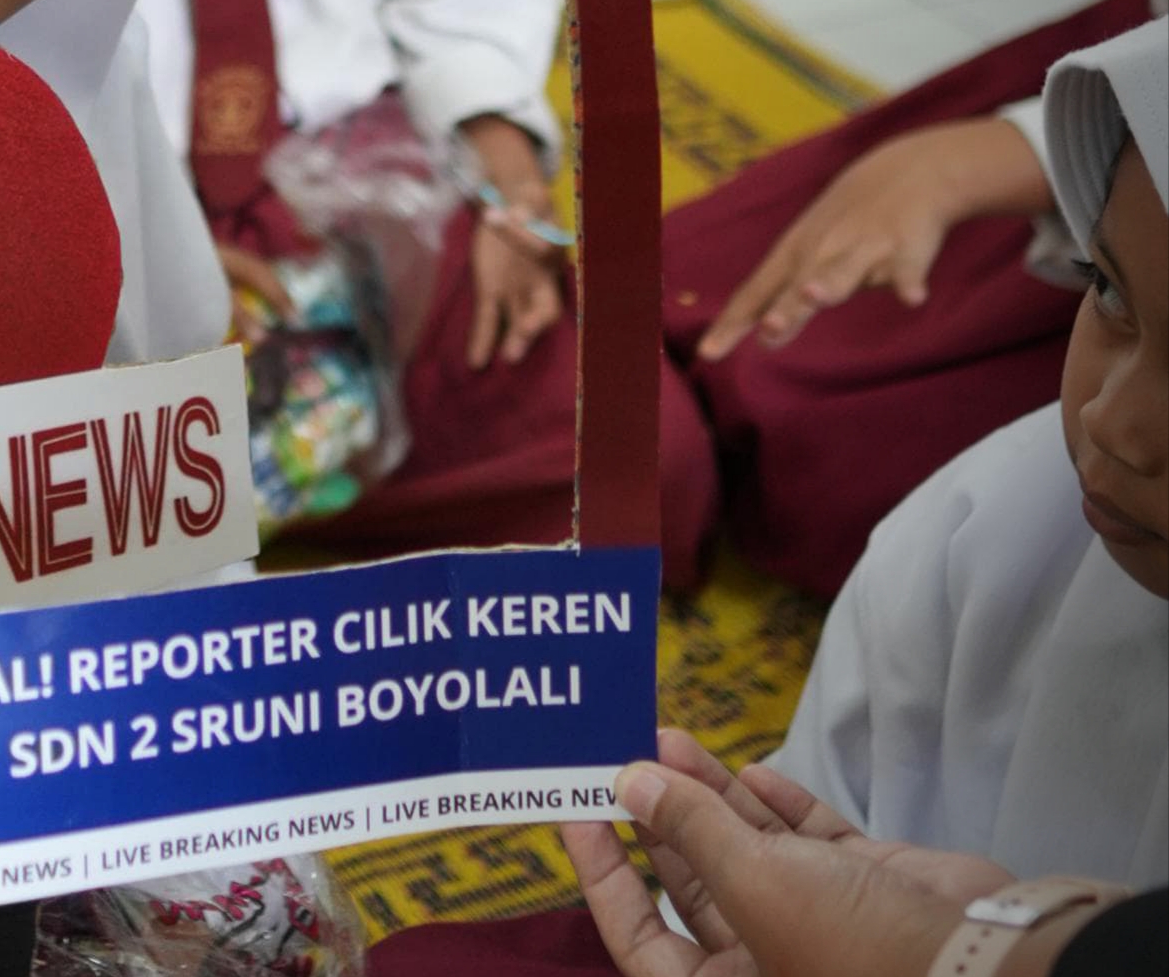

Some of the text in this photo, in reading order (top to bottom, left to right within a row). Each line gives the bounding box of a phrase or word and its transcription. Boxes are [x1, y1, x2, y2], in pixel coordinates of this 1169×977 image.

[69, 619, 320, 695] REPORTER
[333, 599, 452, 654] CILIK
[467, 592, 632, 638] KEREN
[10, 720, 114, 779] SDN
[130, 715, 159, 760] 2
[172, 690, 320, 753] SRUNI
[337, 665, 581, 728] BOYOLALI
[1, 857, 73, 887] NEWS
[101, 843, 151, 870] LIVE
[159, 822, 280, 861] BREAKING
[288, 810, 355, 840] NEWS
[382, 798, 429, 824] LIVE
[437, 788, 563, 816] BREAKING
